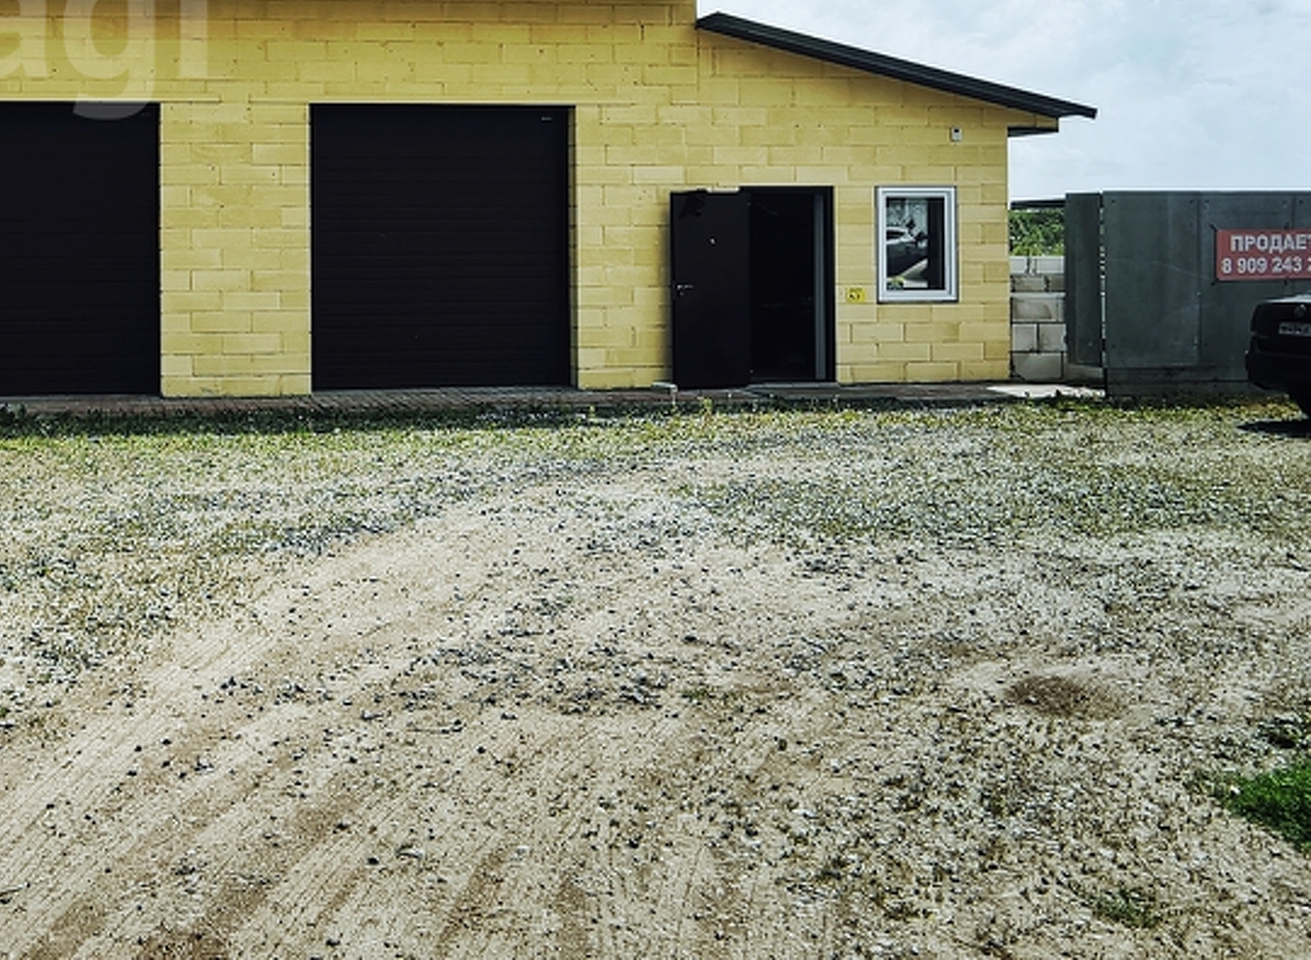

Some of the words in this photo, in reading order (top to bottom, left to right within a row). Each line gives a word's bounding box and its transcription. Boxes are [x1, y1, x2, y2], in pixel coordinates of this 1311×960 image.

[1222, 257, 1232, 273] 8
[1237, 257, 1267, 273] 909
[1272, 256, 1302, 273] 243
